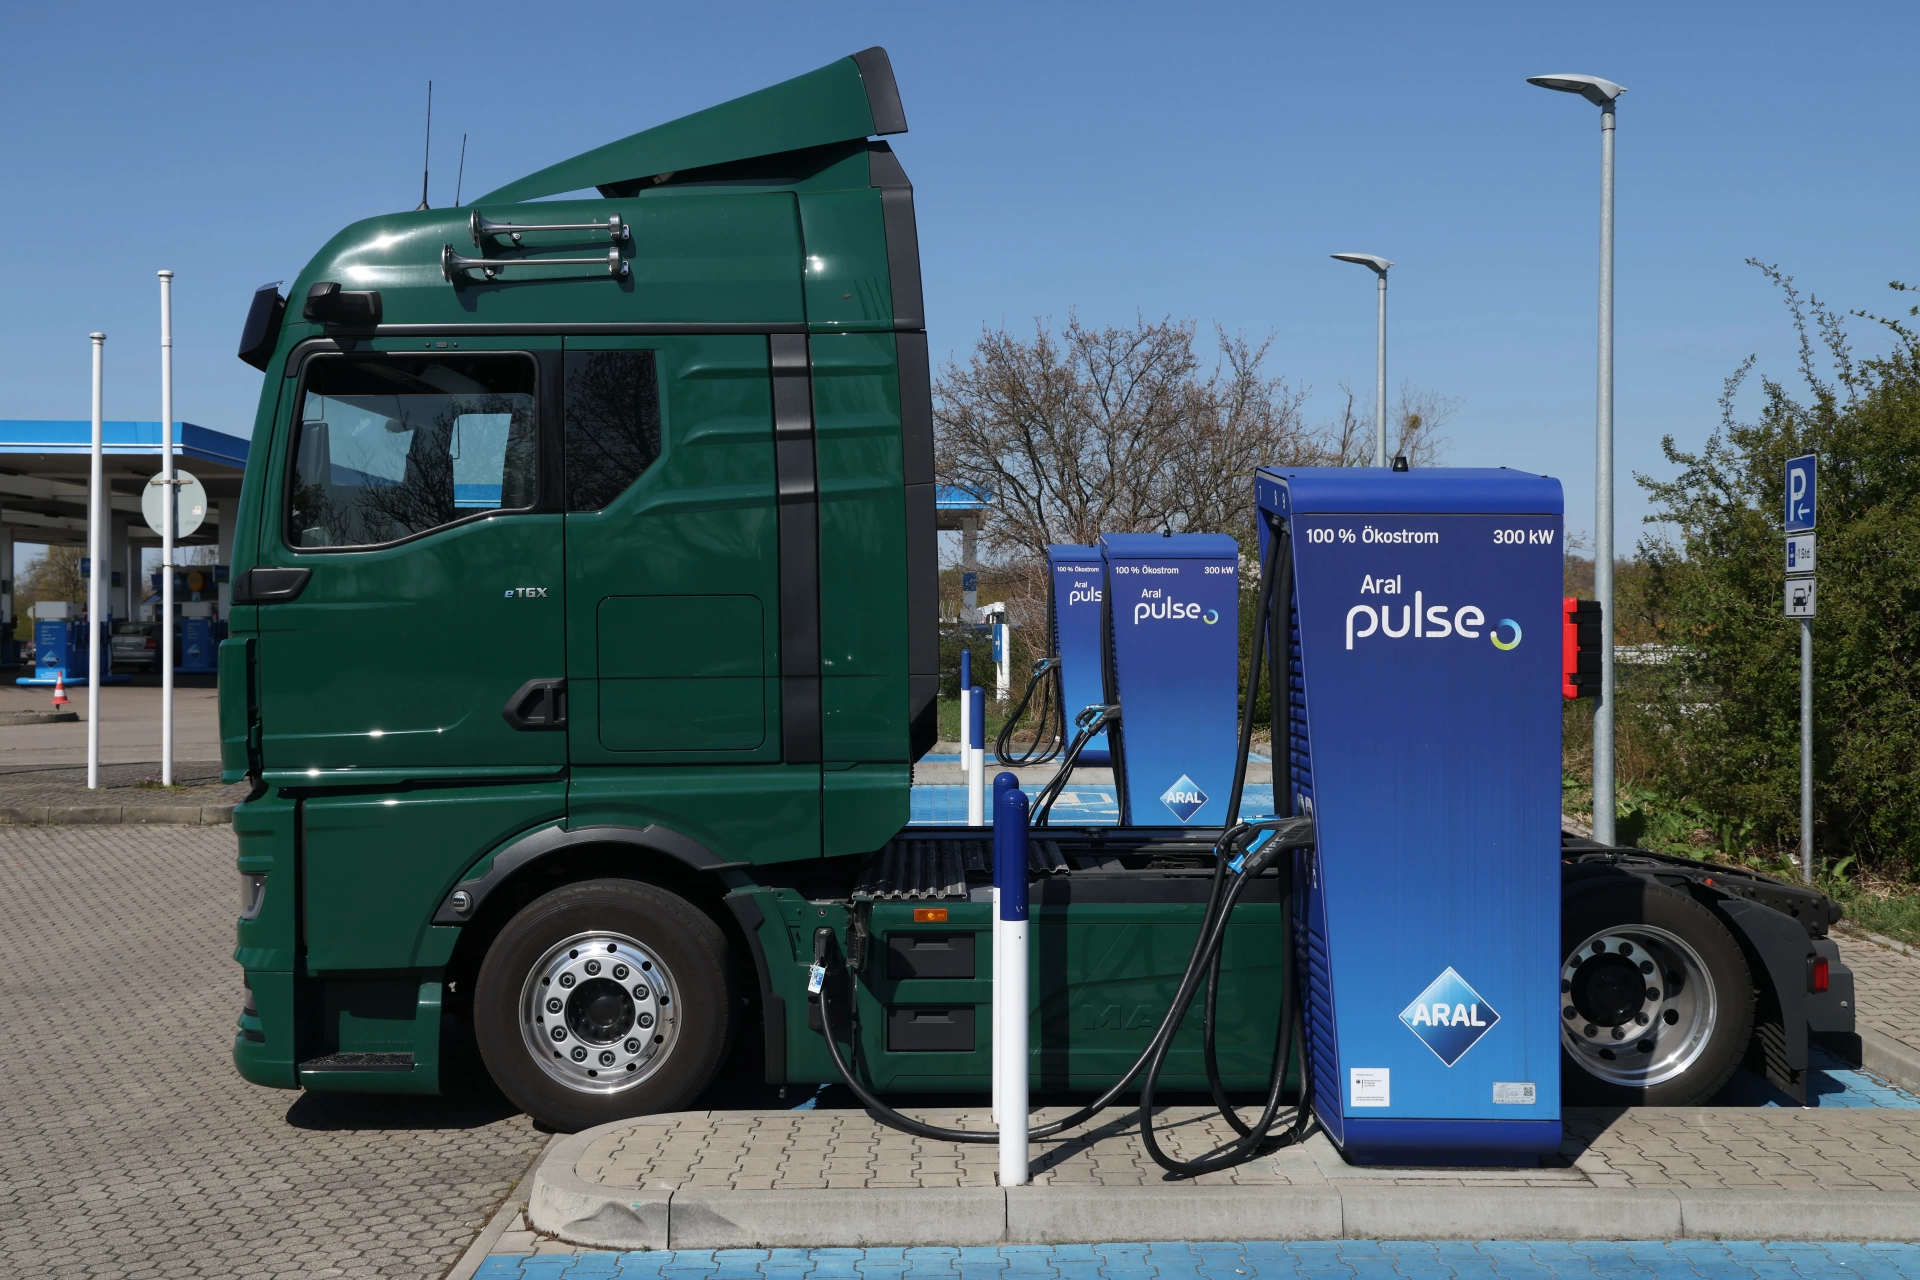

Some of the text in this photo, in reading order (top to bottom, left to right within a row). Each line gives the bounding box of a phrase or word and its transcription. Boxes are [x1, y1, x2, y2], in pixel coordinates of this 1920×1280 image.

[1789, 468, 1806, 521] P
[1306, 526, 1439, 544] 100 % Ökostrom
[1493, 530, 1555, 545] 300 kW
[1075, 565, 1100, 573] Ökostrom
[1115, 565, 1179, 575] 100 % Ökostrom
[1204, 567, 1234, 575] 300 kW
[1074, 581, 1088, 589] Aral
[1361, 574, 1401, 594] Aral
[1141, 589, 1162, 599] Aral
[1134, 596, 1201, 625] pulse
[1346, 590, 1485, 650] pulse
[1166, 791, 1203, 804] ARAL
[1411, 1003, 1487, 1027] ARAL
